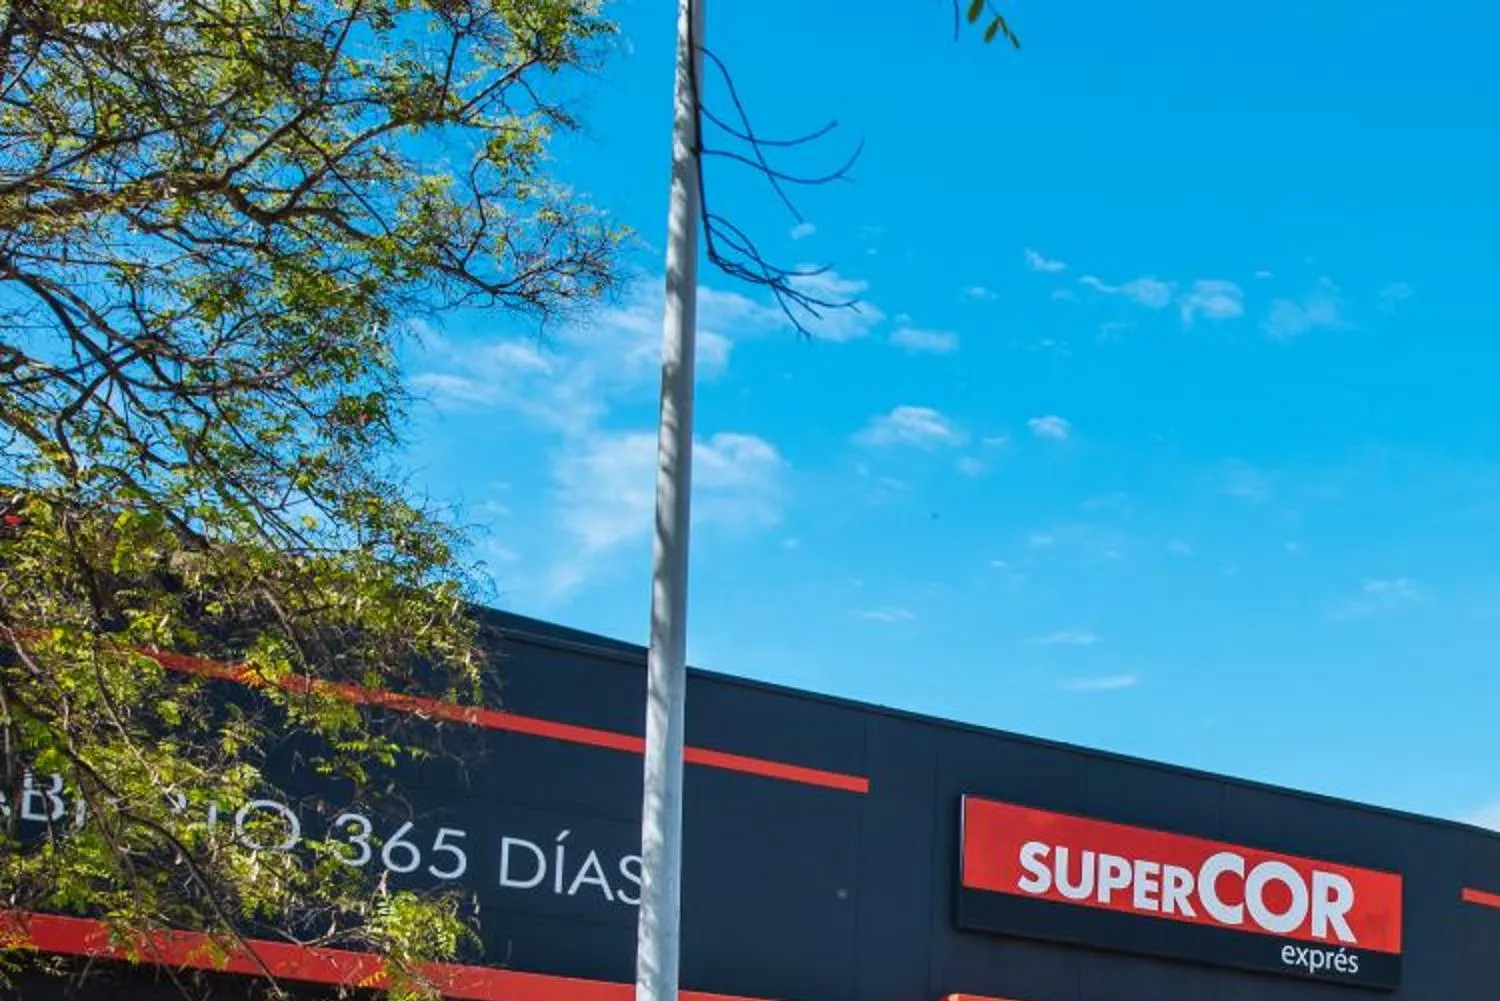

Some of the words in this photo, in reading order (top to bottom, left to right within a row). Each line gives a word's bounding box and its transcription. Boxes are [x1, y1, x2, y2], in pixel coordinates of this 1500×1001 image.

[331, 813, 467, 879] 365
[499, 829, 643, 905] DÍAS
[1017, 840, 1357, 944] SUPERCOR
[1281, 942, 1359, 974] exprés
